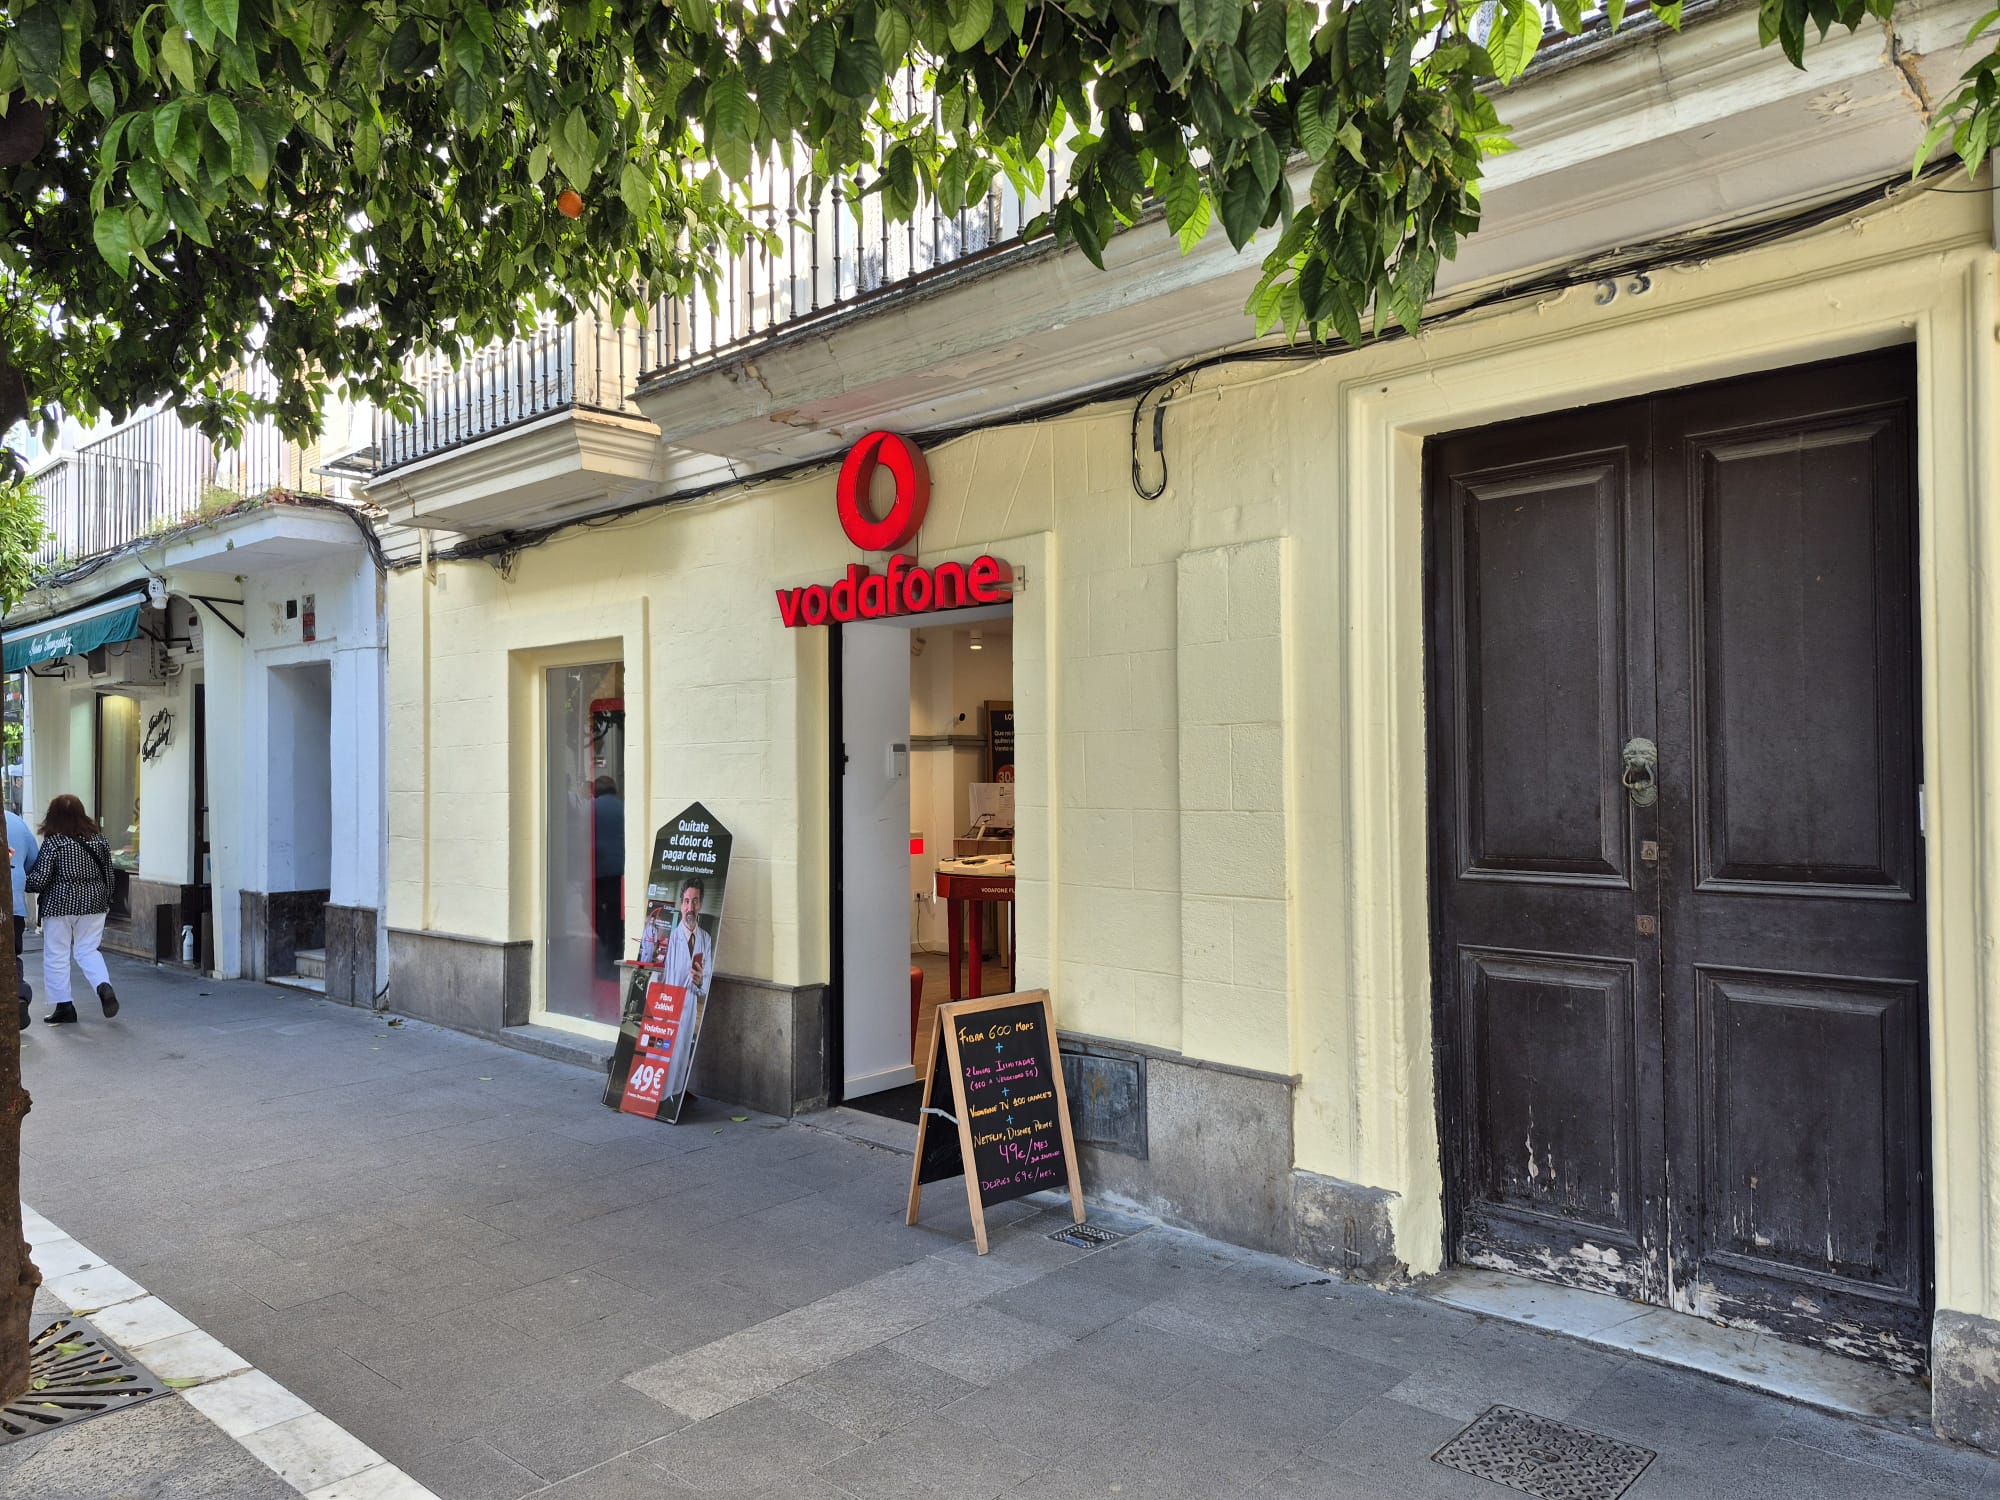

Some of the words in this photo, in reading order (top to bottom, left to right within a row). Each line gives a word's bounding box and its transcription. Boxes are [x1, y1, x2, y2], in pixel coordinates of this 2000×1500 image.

[776, 554, 1014, 628] vodafone
[678, 819, 709, 833] Quítate
[670, 834, 678, 846] el
[679, 834, 702, 848] dolor
[702, 836, 713, 848] de
[662, 849, 687, 863] pagar
[686, 849, 698, 861] de
[698, 850, 717, 863] más
[660, 993, 672, 1003] Fibra
[644, 1023, 667, 1036] Vodafone
[665, 1028, 675, 1037] TV
[989, 1024, 1012, 1040] 600
[630, 1063, 665, 1093] 49€
